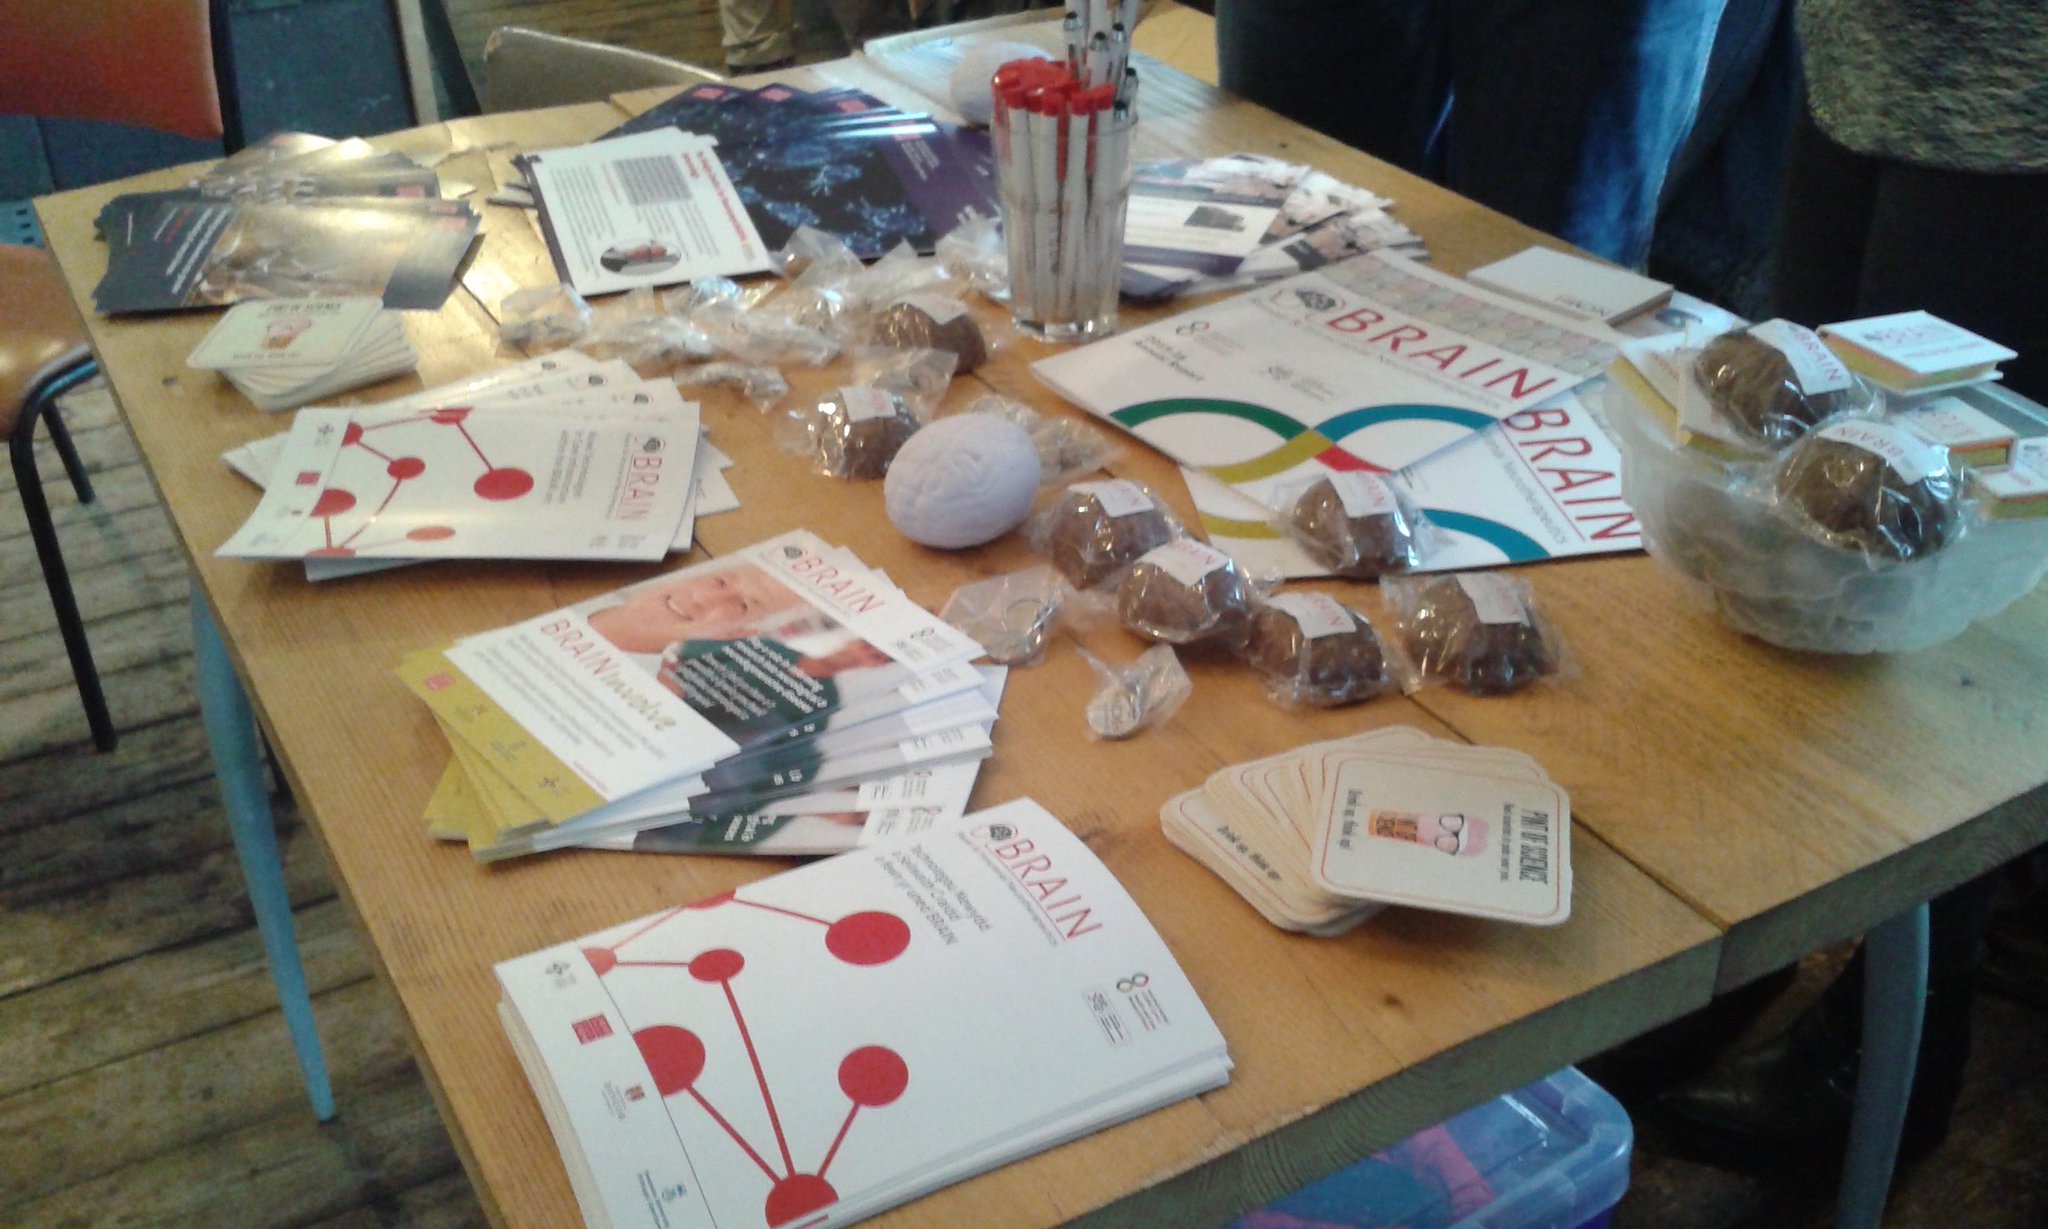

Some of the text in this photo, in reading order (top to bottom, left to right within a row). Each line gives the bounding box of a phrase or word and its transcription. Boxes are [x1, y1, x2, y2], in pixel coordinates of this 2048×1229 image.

[1327, 308, 1557, 400] BRAIN
[617, 456, 663, 521] BRAIN
[1502, 408, 1641, 541] BRAIN
[792, 556, 886, 615] BRAIN
[540, 619, 620, 677] BRAIN
[1519, 844, 1548, 885] SCIENCE
[1521, 832, 1548, 845] OF
[996, 838, 1103, 940] BRAIN
